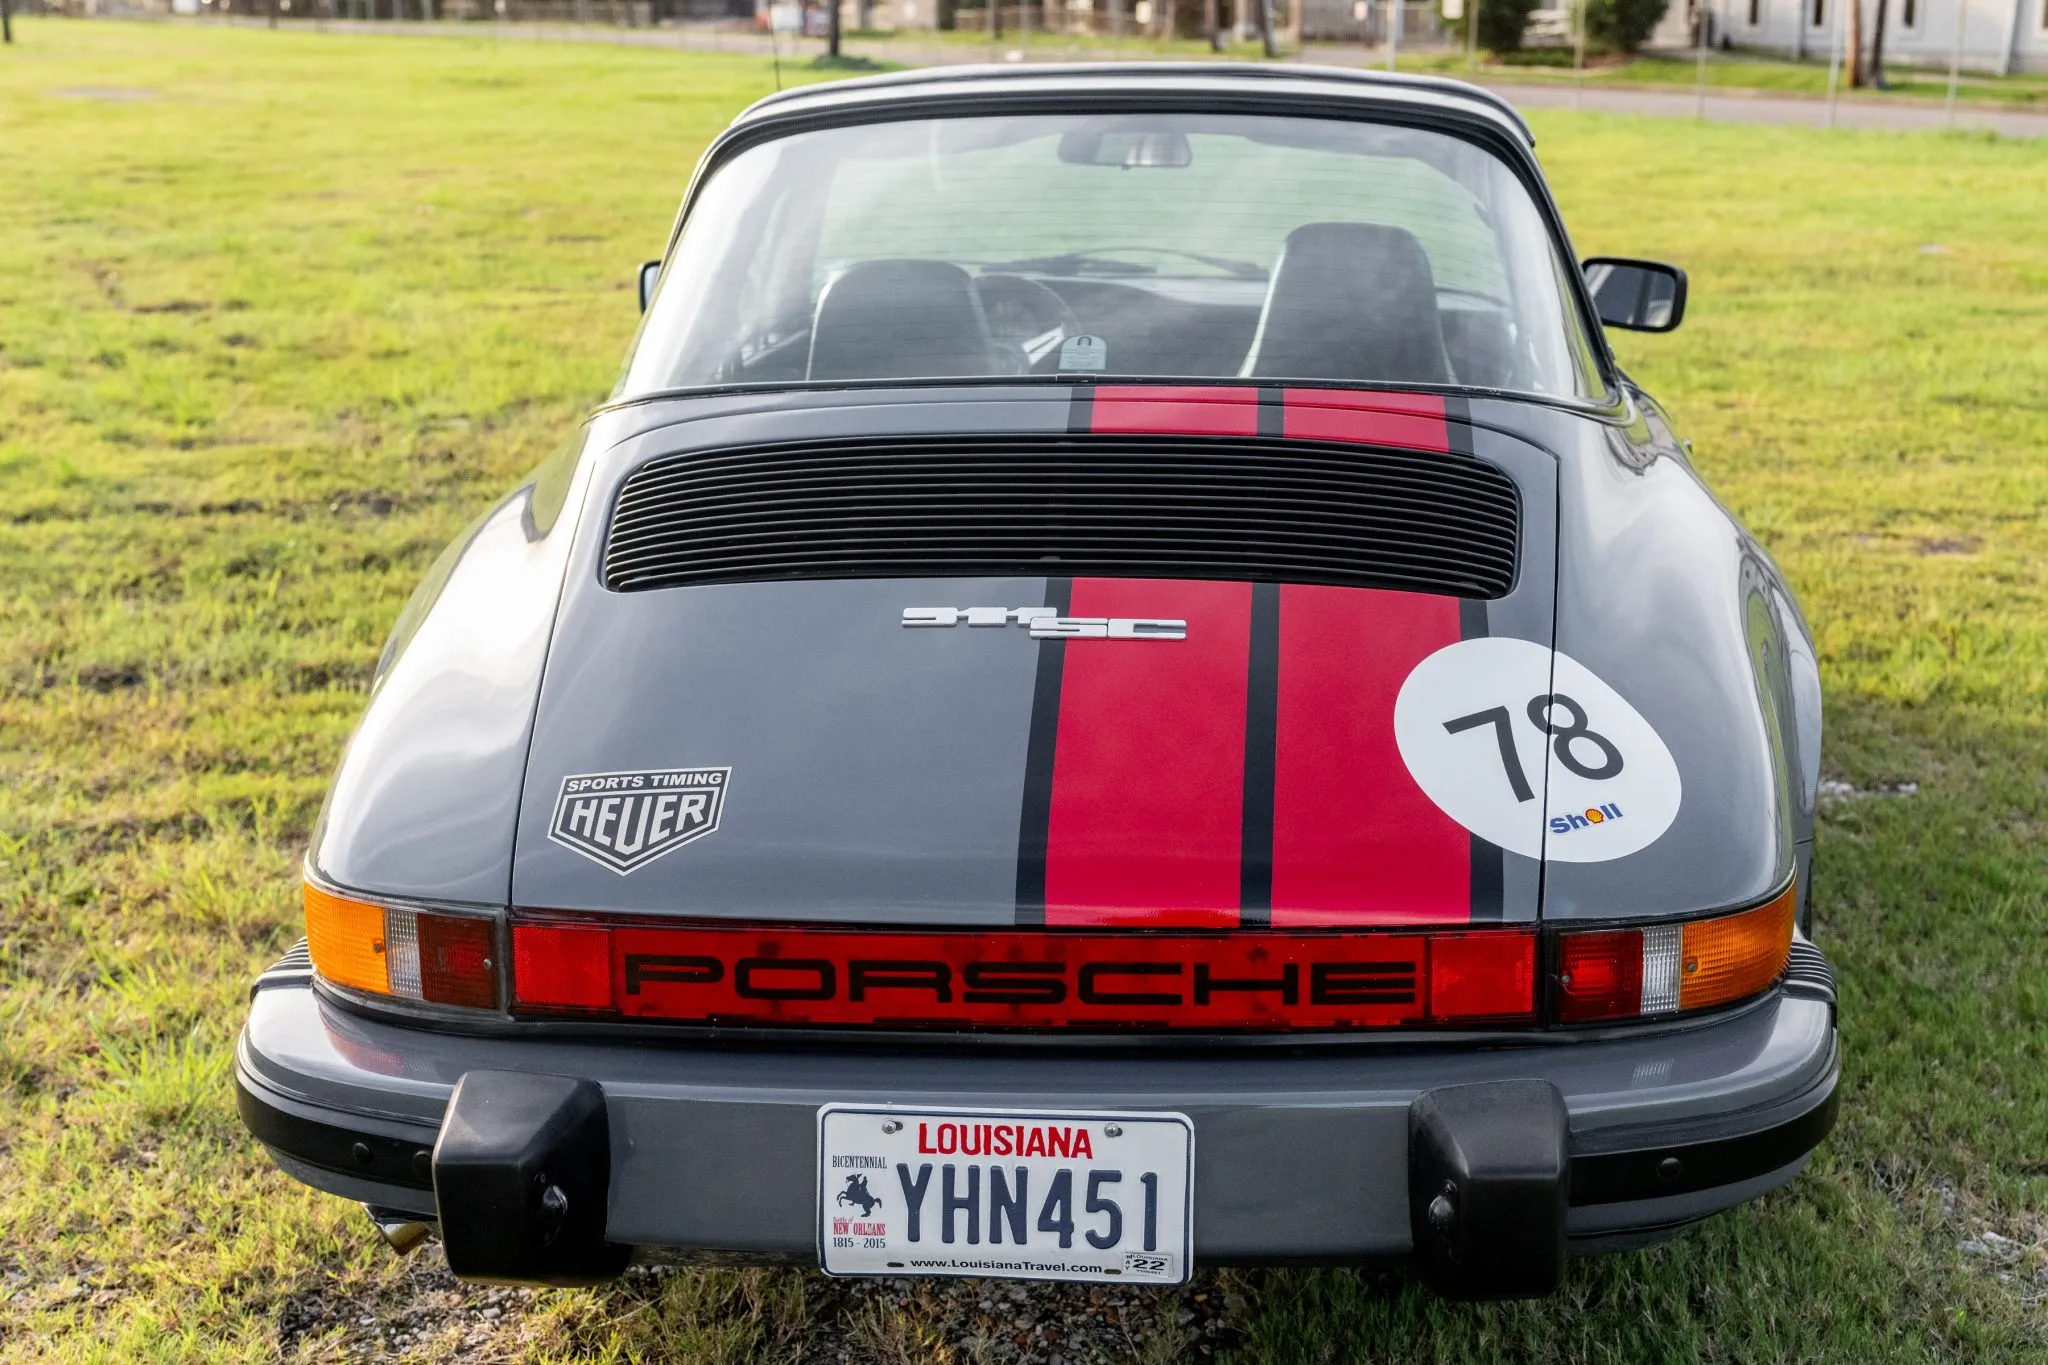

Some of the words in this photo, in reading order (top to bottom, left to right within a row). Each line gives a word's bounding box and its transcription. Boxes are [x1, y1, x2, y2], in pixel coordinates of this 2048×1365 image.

[1442, 693, 1624, 803] 78
[567, 776, 645, 792] SPORTS
[650, 772, 723, 787] TIMING
[569, 794, 707, 855] HEUER
[1550, 803, 1623, 834] Shll
[625, 953, 1416, 1005] PORSCHE
[918, 1122, 1092, 1159] LOUISIANA
[832, 1155, 887, 1169] BICENTENNIAL
[896, 1163, 1158, 1252] YHN451
[833, 1223, 849, 1235] NEW
[853, 1223, 886, 1236] ORLEANS
[833, 1237, 854, 1248] 1815
[863, 1238, 885, 1249] 2015
[910, 1257, 1102, 1274] www.LouisianaTravel.com
[1132, 1258, 1165, 1271] 22
